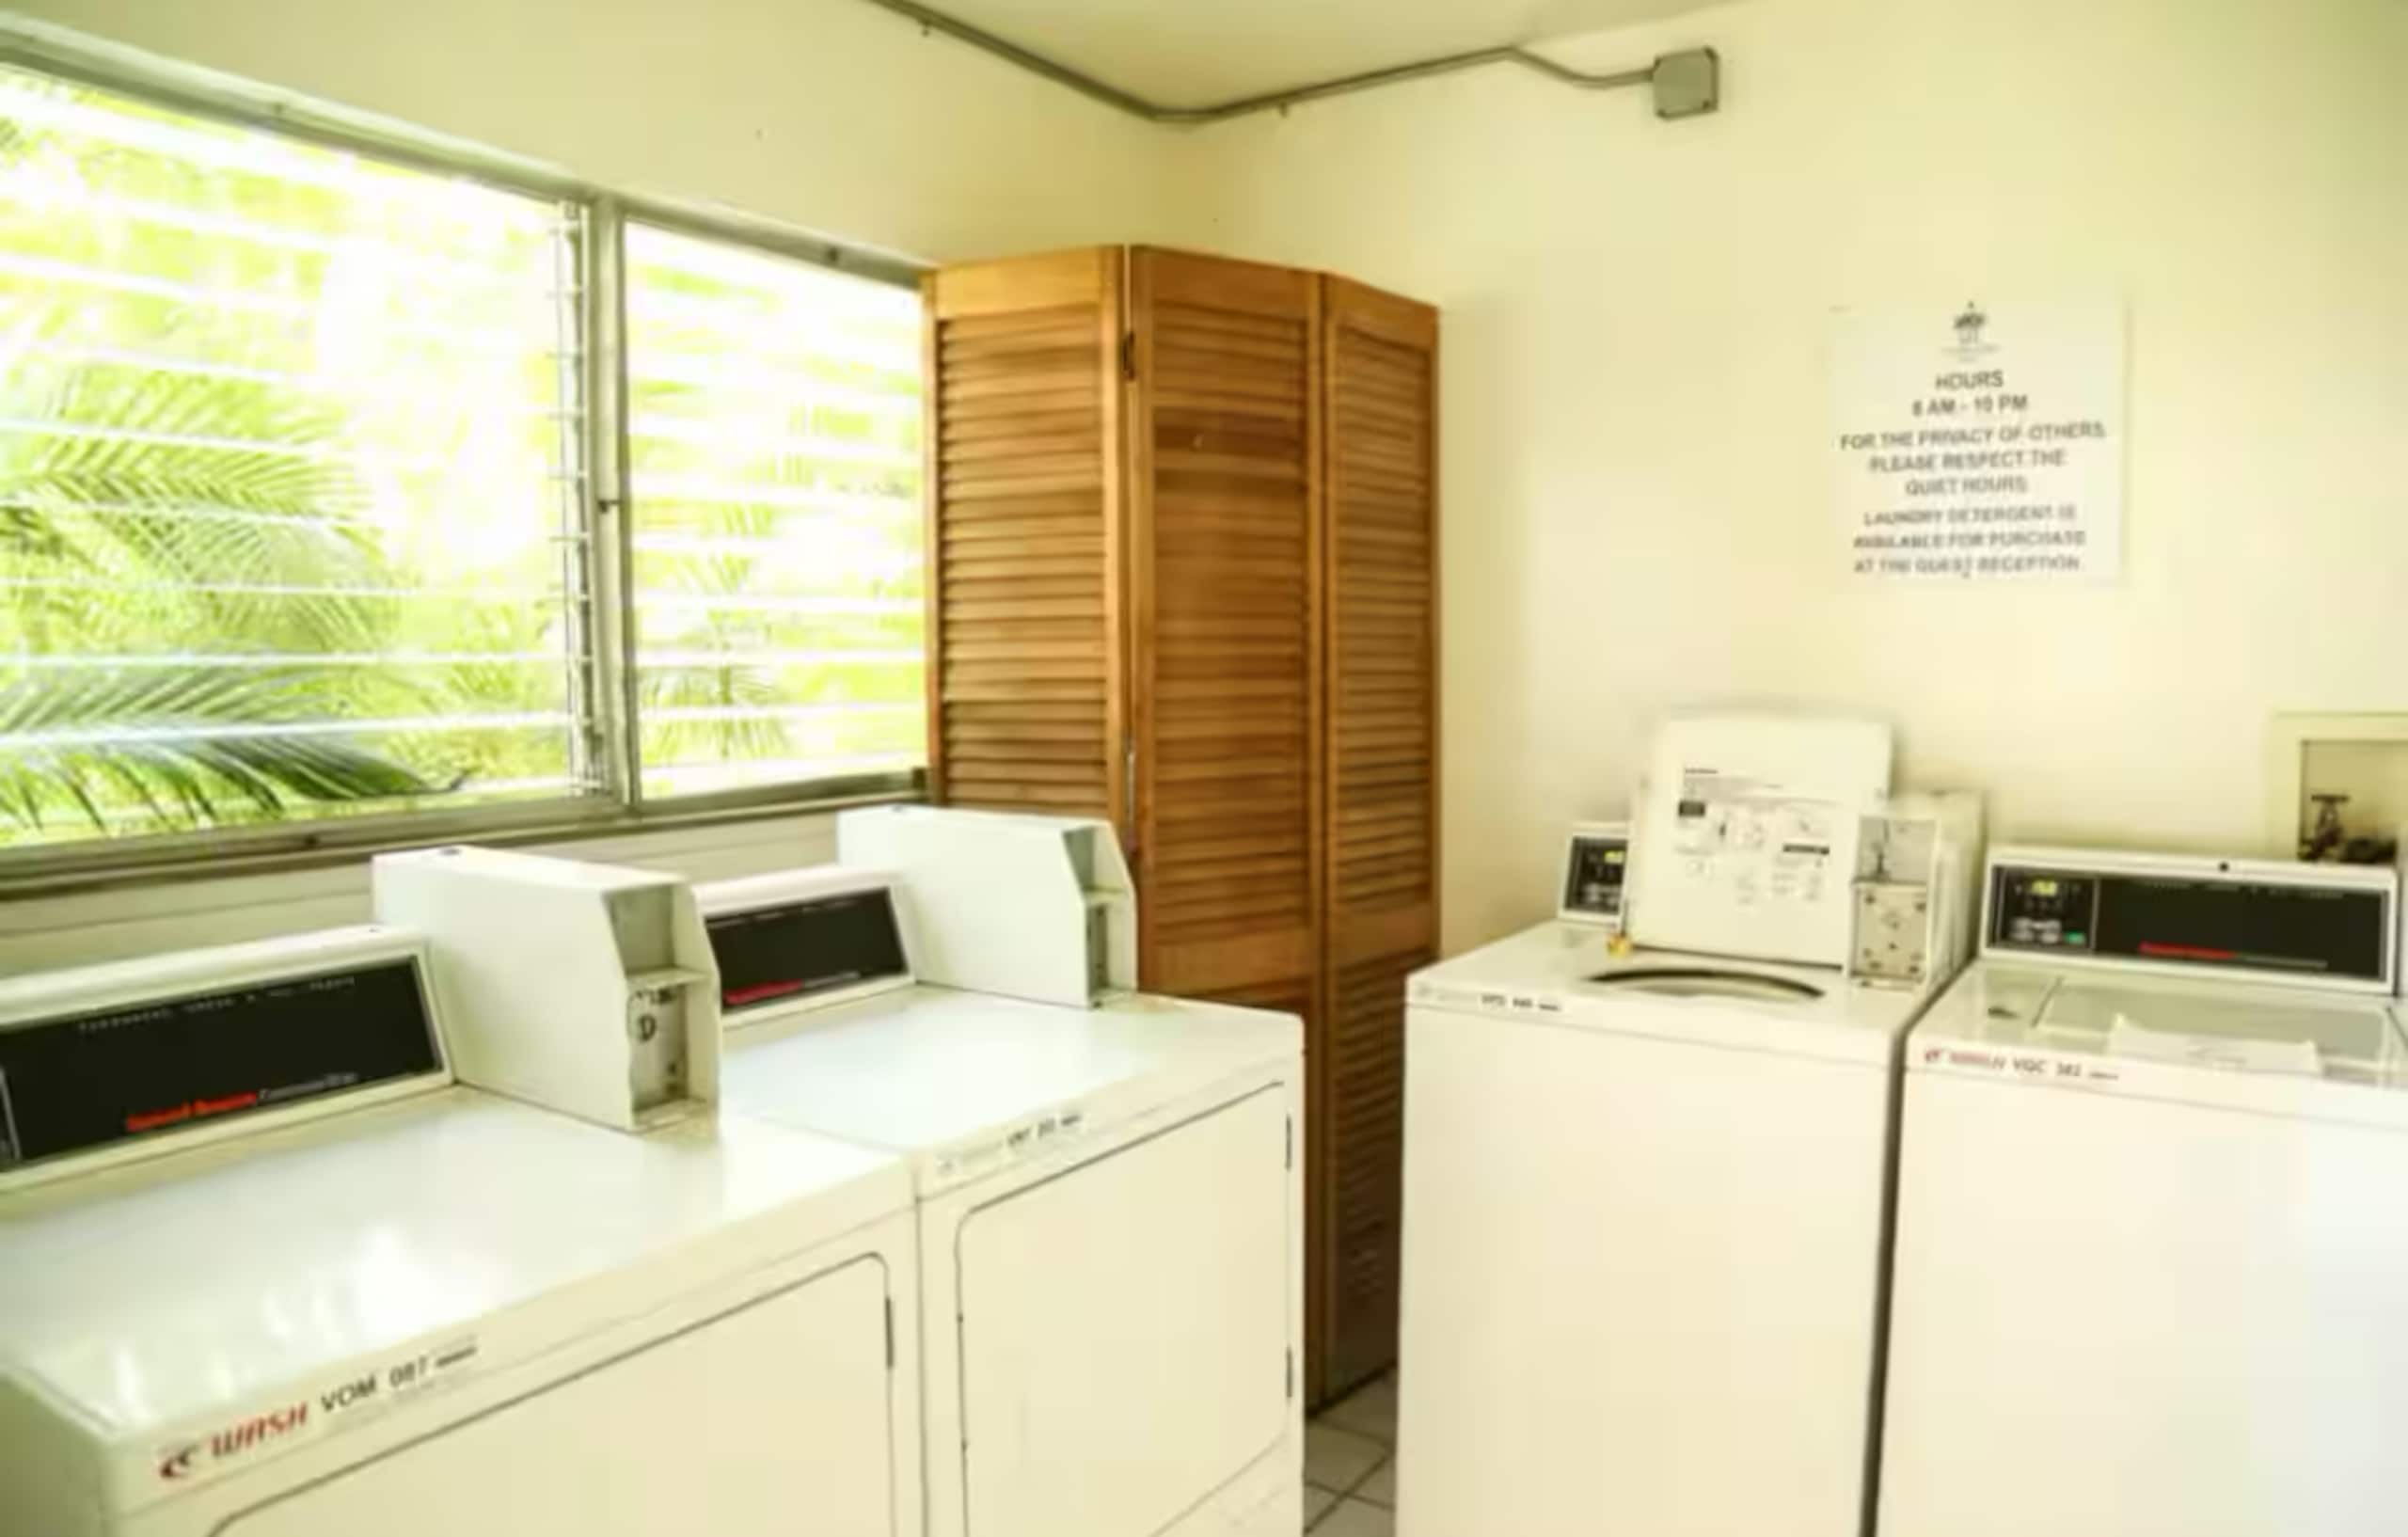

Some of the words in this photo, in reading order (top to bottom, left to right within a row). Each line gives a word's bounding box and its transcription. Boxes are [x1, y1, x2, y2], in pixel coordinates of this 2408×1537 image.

[1935, 370, 2004, 389] HOURS
[1927, 399, 1956, 417] AM
[1973, 396, 1993, 414] 10
[1999, 394, 2029, 412] PM
[1841, 432, 1877, 451] FOR
[1880, 431, 1913, 447] THE
[1918, 426, 1993, 447] PRIVACY
[1998, 424, 2023, 443] OF
[2027, 420, 2106, 441] OTHERS
[1870, 454, 1935, 473] PLEASE
[1941, 451, 2023, 470] RESPECT
[2031, 448, 2067, 467] THE
[1905, 478, 1956, 497] QUIET
[1962, 475, 2028, 495] HOURS
[1863, 509, 1943, 527] LAUNDRY
[1947, 505, 2052, 524] DETERGENT
[1948, 531, 1984, 548] FOR
[1854, 557, 1875, 575] AT
[210, 1401, 309, 1459] WASH
[320, 1374, 377, 1412] VOM
